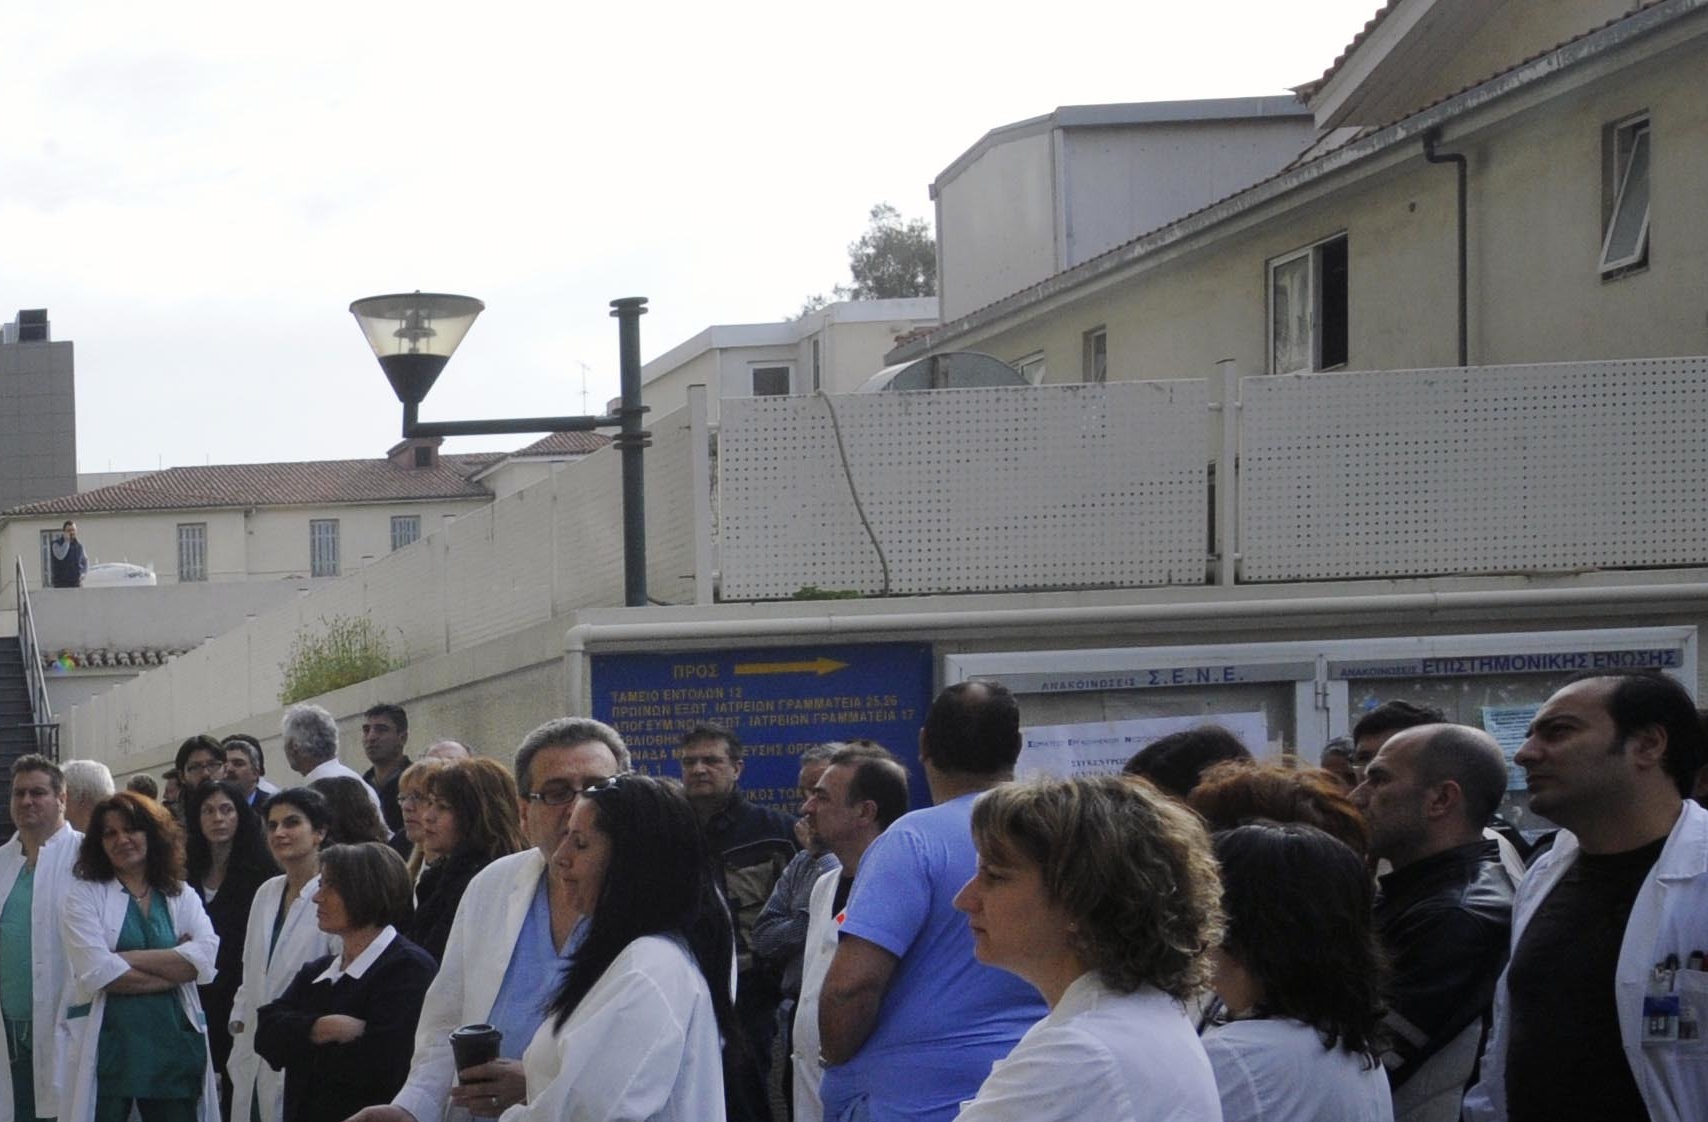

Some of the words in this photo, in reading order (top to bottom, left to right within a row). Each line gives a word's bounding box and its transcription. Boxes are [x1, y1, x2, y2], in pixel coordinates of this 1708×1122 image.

[673, 664, 719, 679] ΠΡΟΣ
[1422, 652, 1589, 674] ΕΠΙΣΤΗΜΟΝΙΚΗΣ
[1594, 649, 1676, 668] ΕΝΩΣΗΣ
[1148, 666, 1245, 686] Σ.Ε.Ν.Ε.
